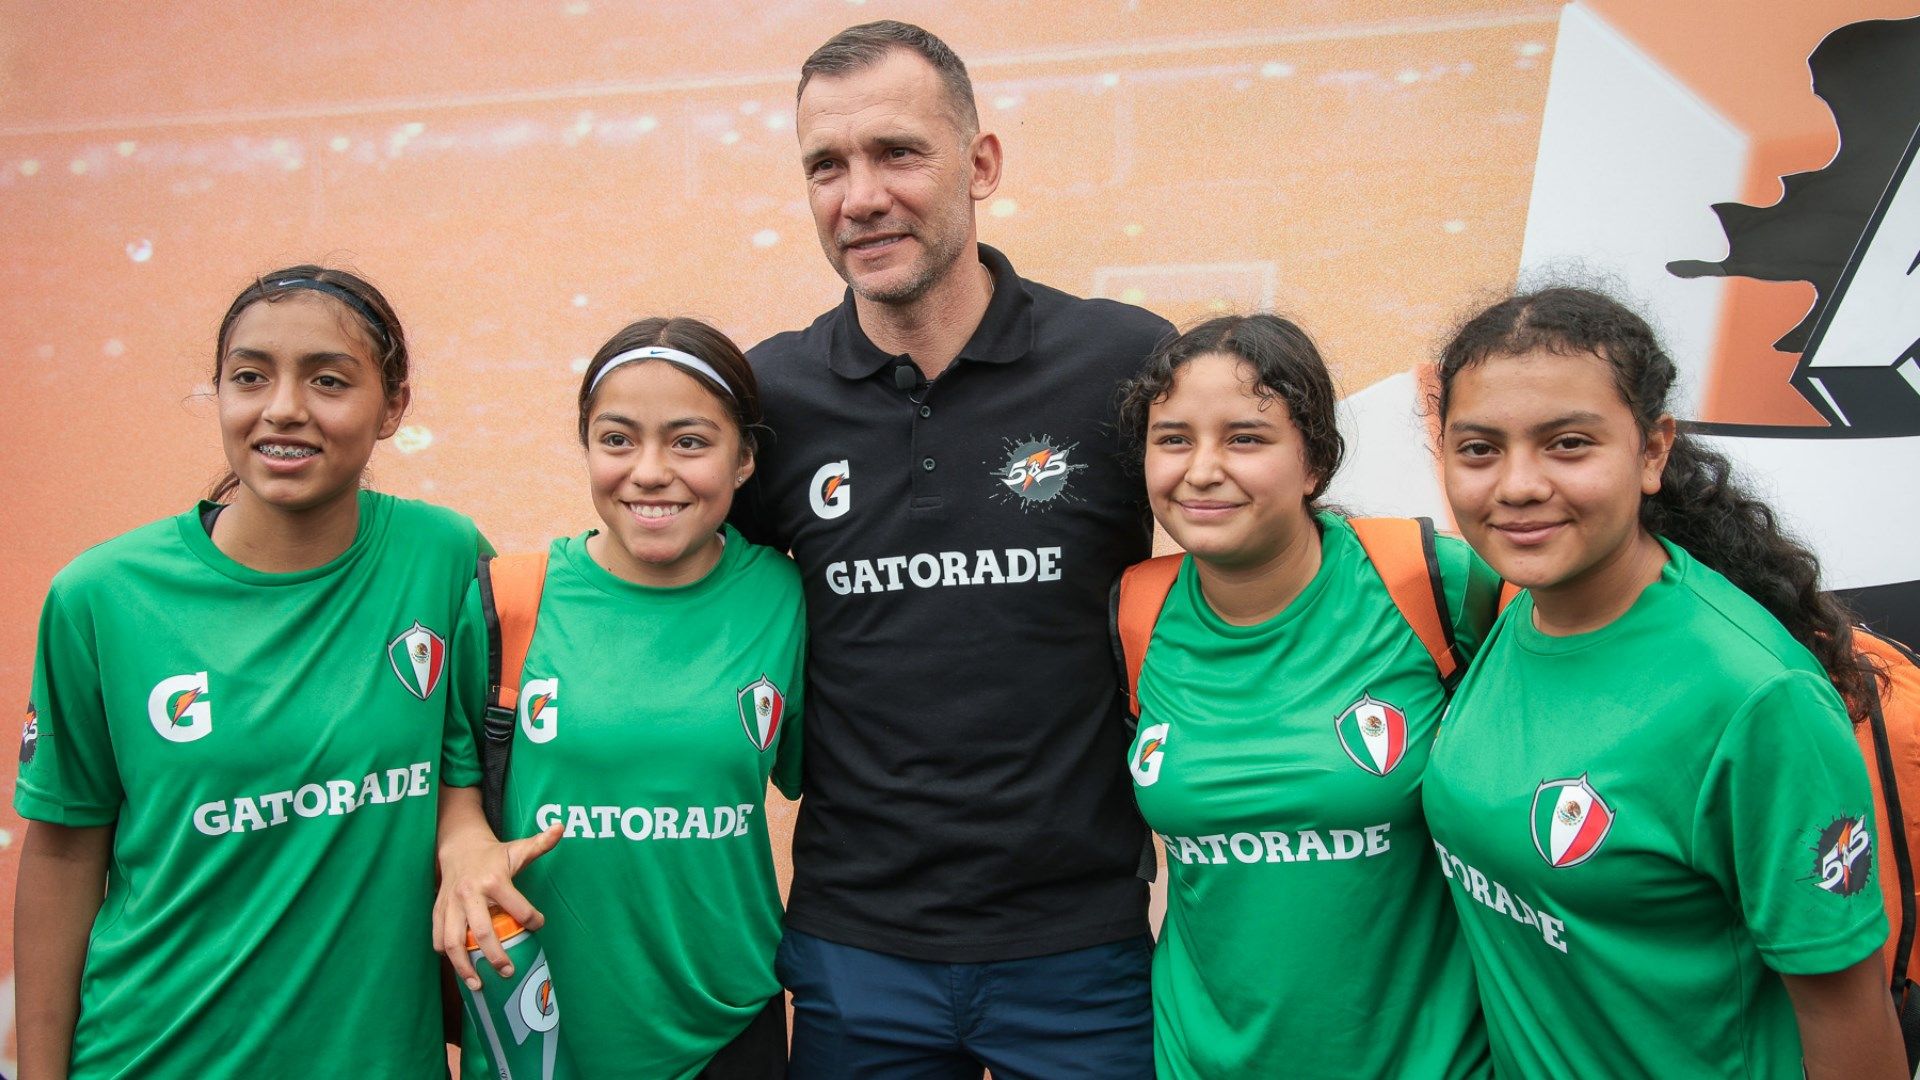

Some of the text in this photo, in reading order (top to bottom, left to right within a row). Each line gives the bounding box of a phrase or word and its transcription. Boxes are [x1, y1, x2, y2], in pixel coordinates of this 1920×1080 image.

[809, 459, 850, 520] G
[825, 546, 1062, 596] GATORADE
[148, 671, 212, 743] G
[520, 677, 558, 744] G
[193, 761, 431, 836] GATORADE
[536, 803, 754, 841] GATORADE
